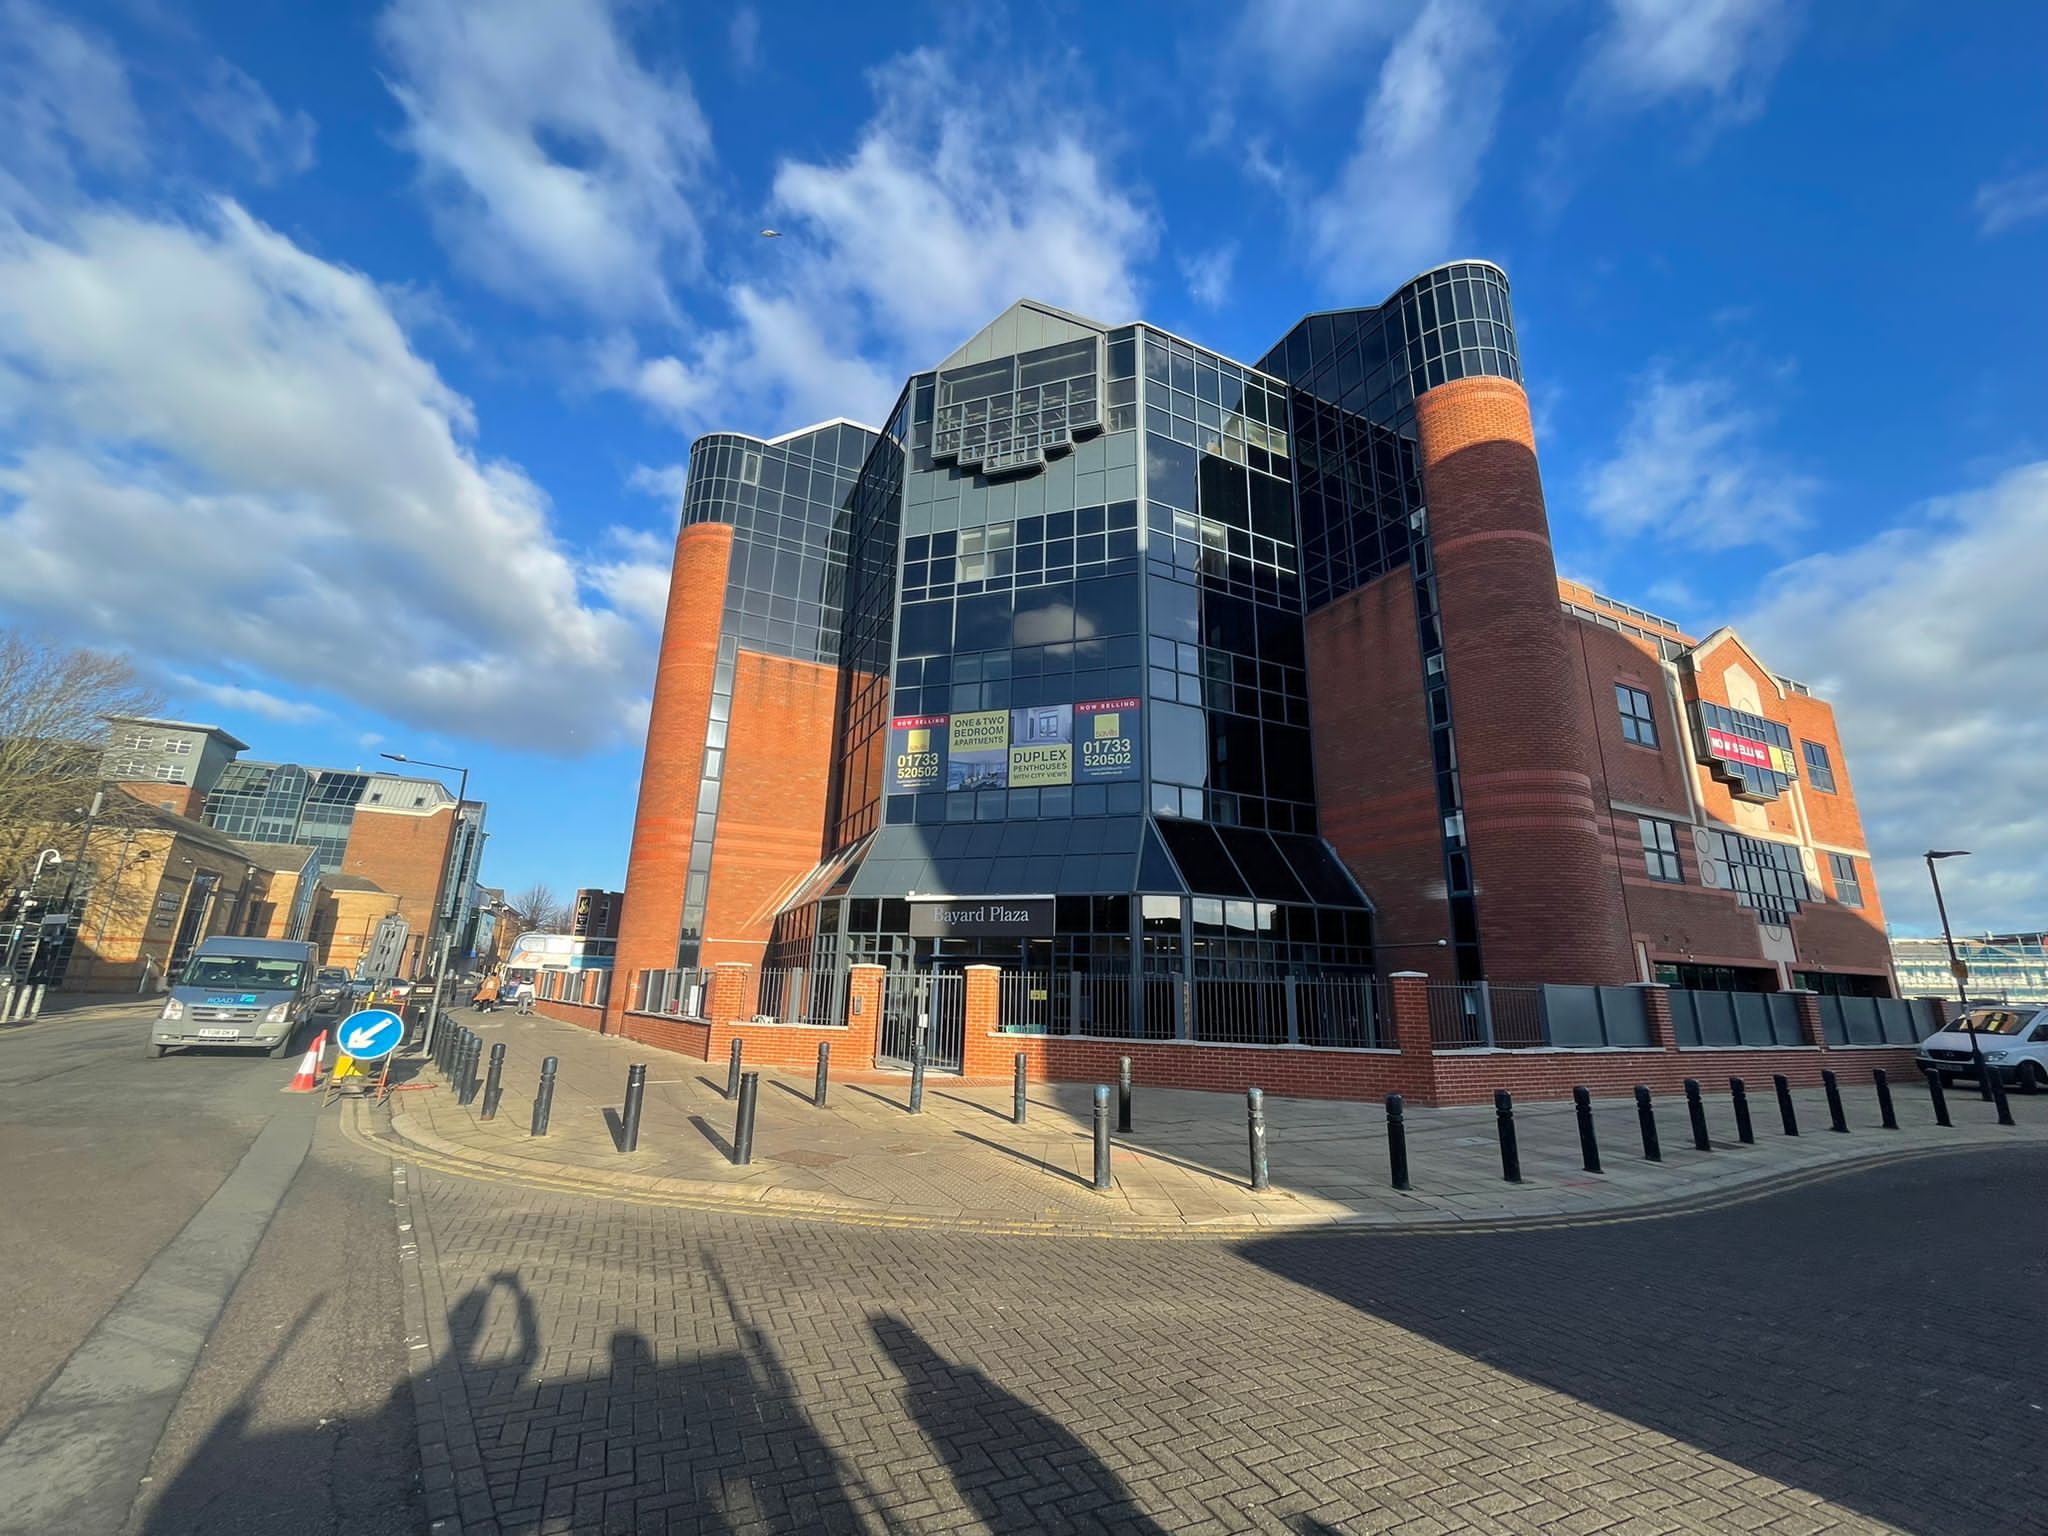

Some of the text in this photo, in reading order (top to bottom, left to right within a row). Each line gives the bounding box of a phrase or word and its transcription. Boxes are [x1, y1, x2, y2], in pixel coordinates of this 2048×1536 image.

[954, 719, 974, 728] ONE
[983, 716, 1005, 725] TWO
[954, 726, 1004, 738] BEDROOM
[954, 735, 1004, 746] APARTMENTS
[1083, 739, 1131, 754] 01733
[897, 753, 938, 768] 01733
[1014, 750, 1067, 763] DUPLEX
[1084, 752, 1131, 767] 520502
[897, 766, 938, 779] 520502
[1013, 762, 1068, 772] PENTHOUSES
[933, 906, 1030, 926] Bayard Plaza
